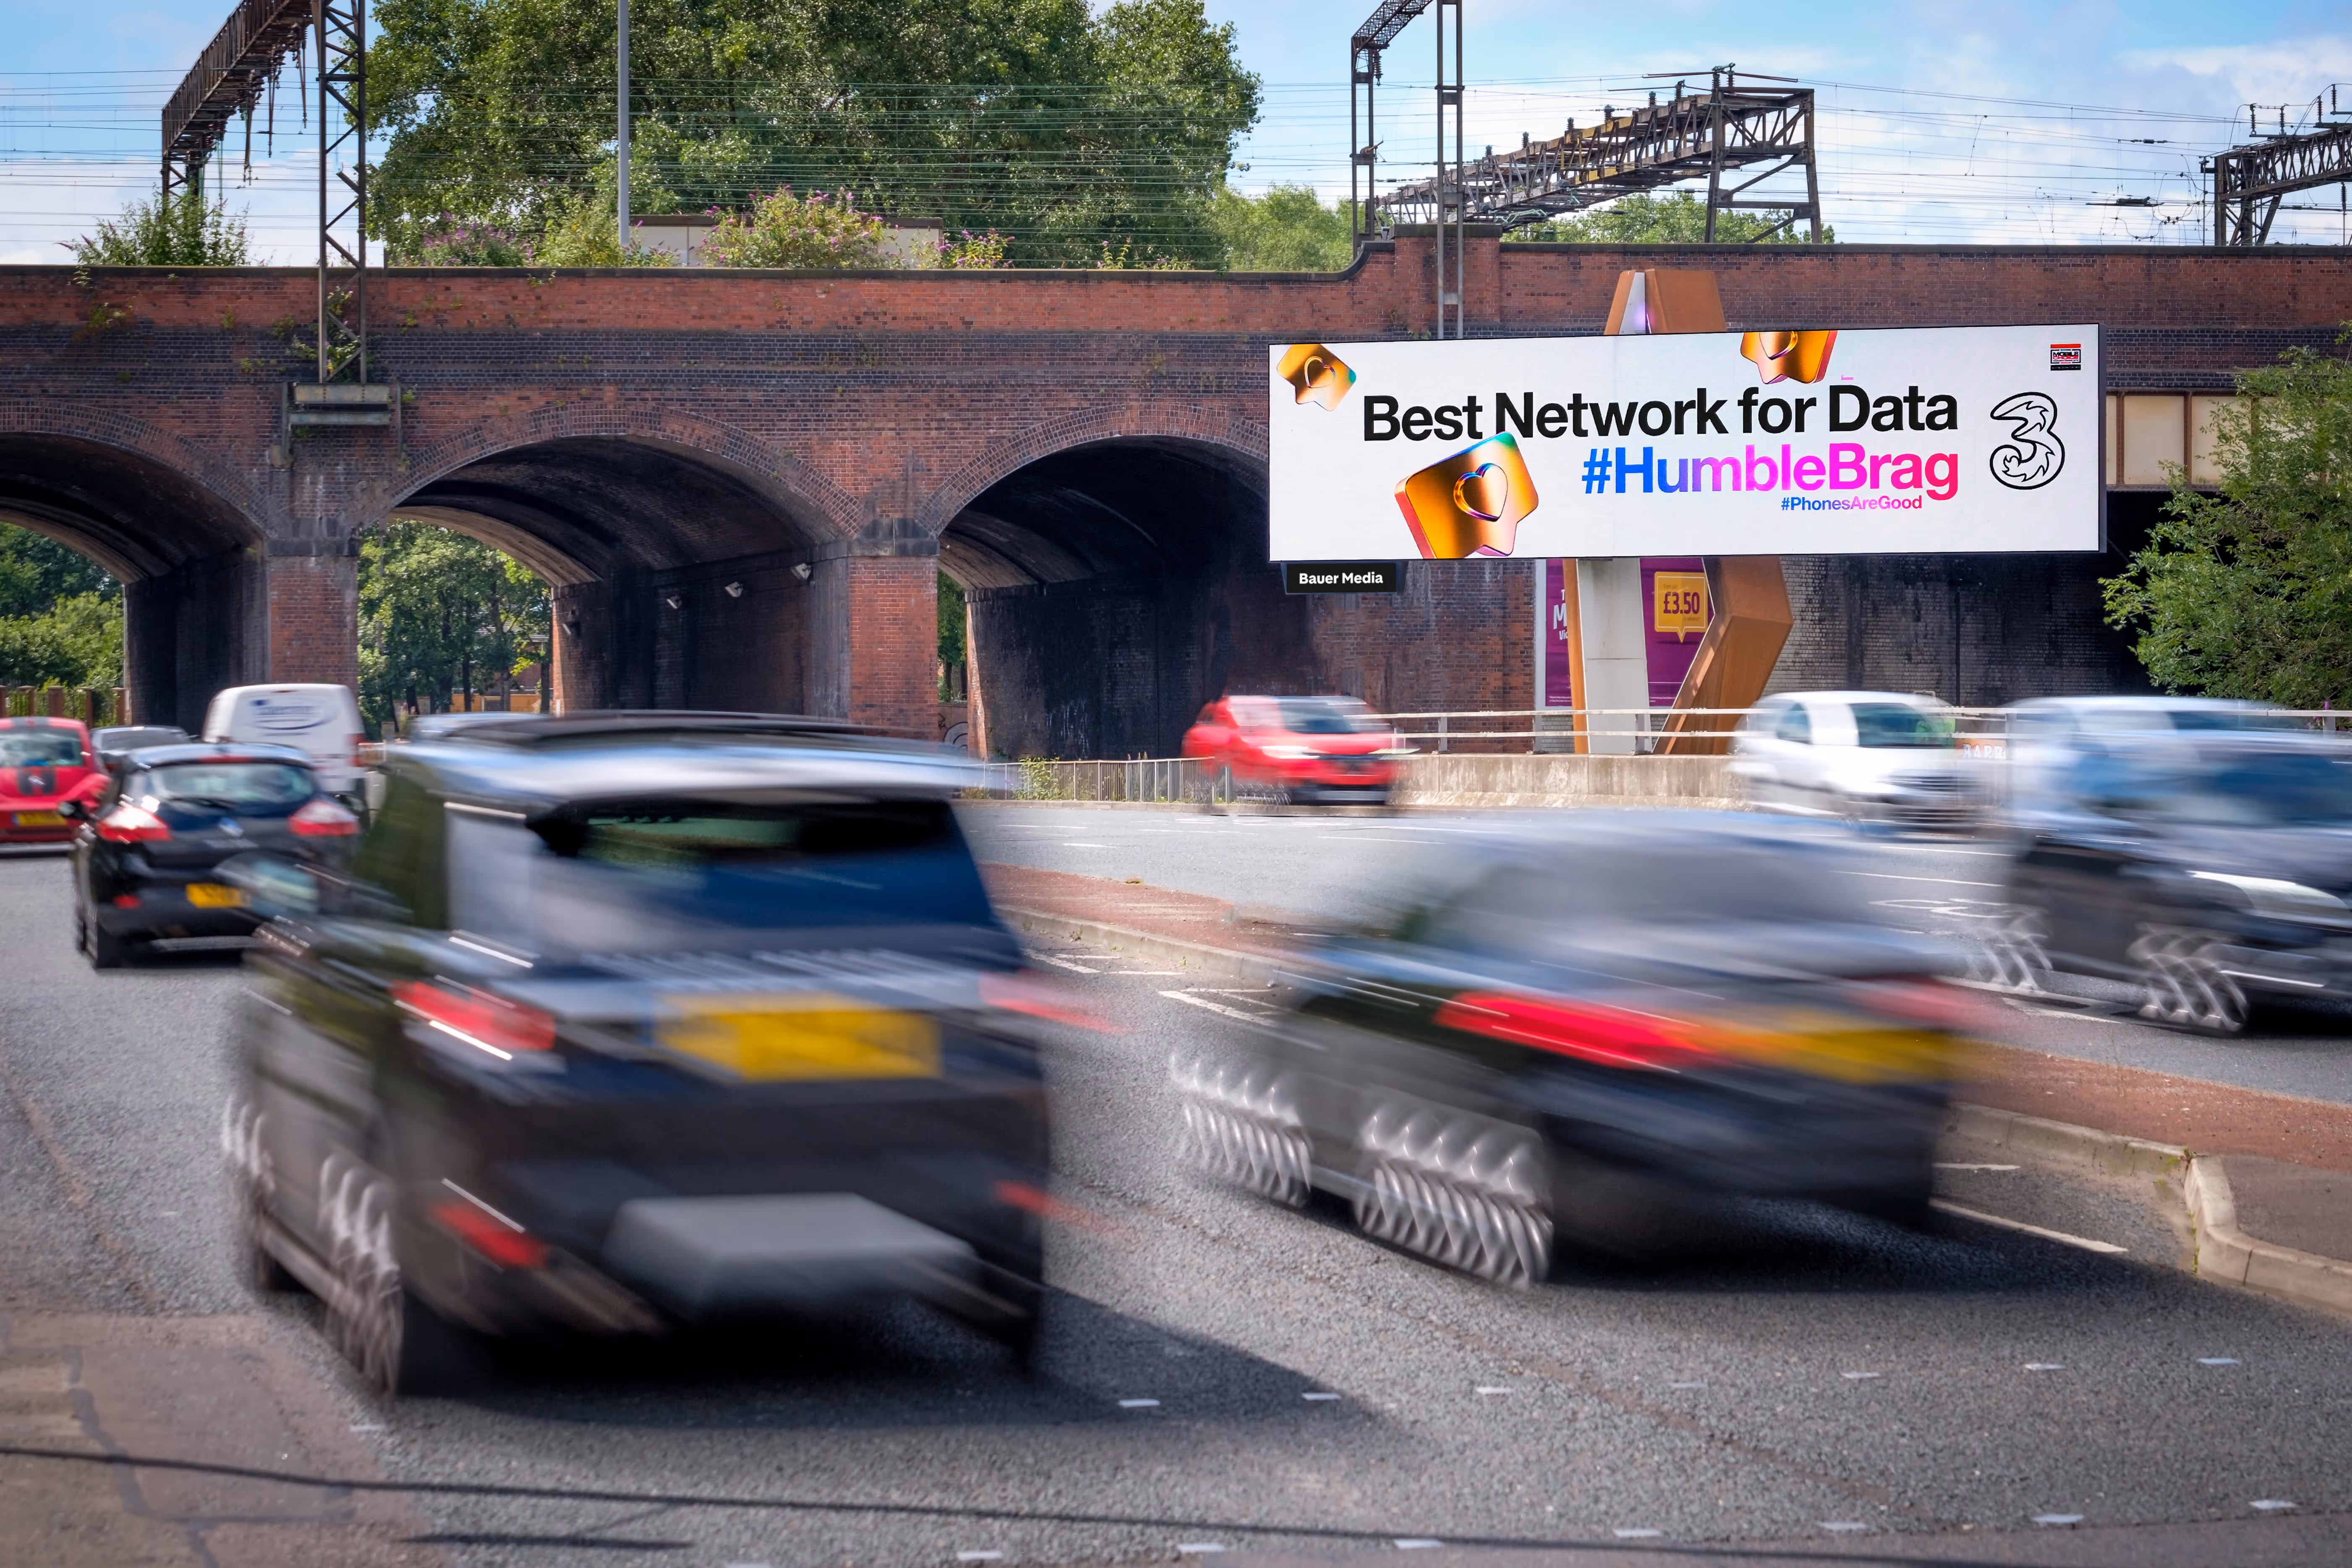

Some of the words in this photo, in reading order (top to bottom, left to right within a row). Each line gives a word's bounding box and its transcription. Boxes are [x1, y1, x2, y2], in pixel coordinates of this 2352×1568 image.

[1364, 395, 1483, 441] Best
[1496, 388, 1729, 438] Network
[1737, 387, 1817, 434] for
[1829, 385, 1958, 432] Data
[1581, 442, 1958, 501] #HumbleBrag
[1781, 495, 1922, 511] #PhonesAreGood
[1299, 573, 1339, 584] Bauer
[1342, 571, 1383, 584] Media
[1663, 592, 1700, 614] £3.50
